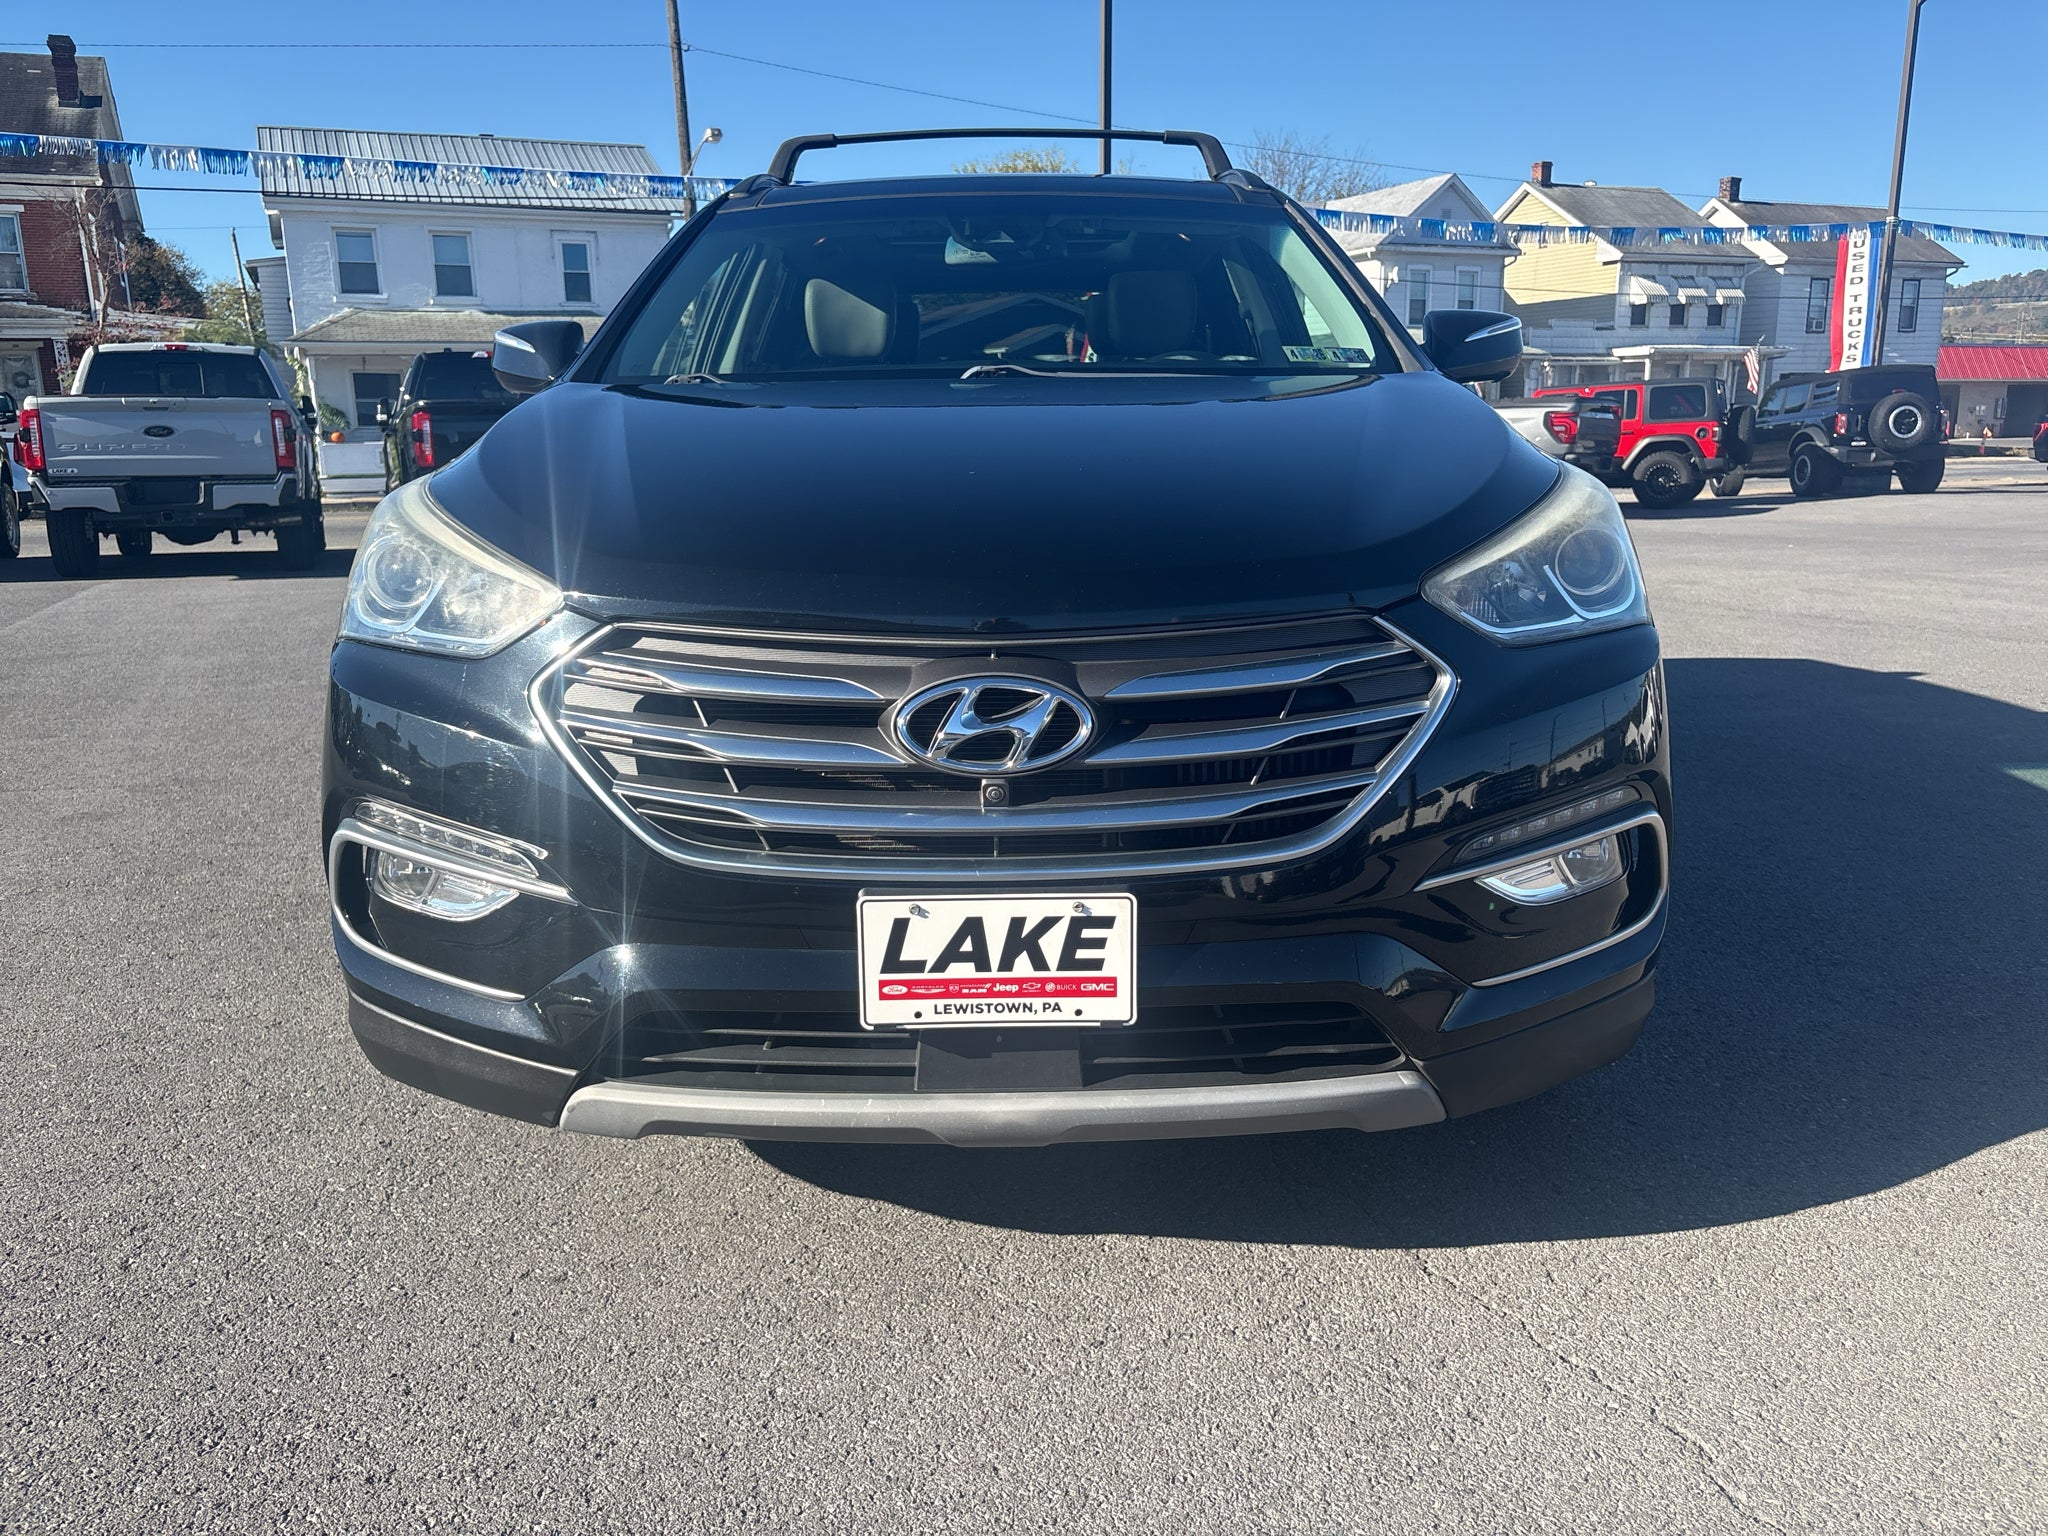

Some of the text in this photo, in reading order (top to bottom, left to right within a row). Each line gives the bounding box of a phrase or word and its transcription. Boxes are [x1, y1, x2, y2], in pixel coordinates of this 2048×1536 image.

[1845, 239, 1866, 363] USED TRUCKS
[880, 915, 1117, 974] LAKE
[993, 983, 1019, 993] Jeep
[1080, 983, 1115, 991] GMC
[934, 1002, 1063, 1015] LEWISTOWN, PA
